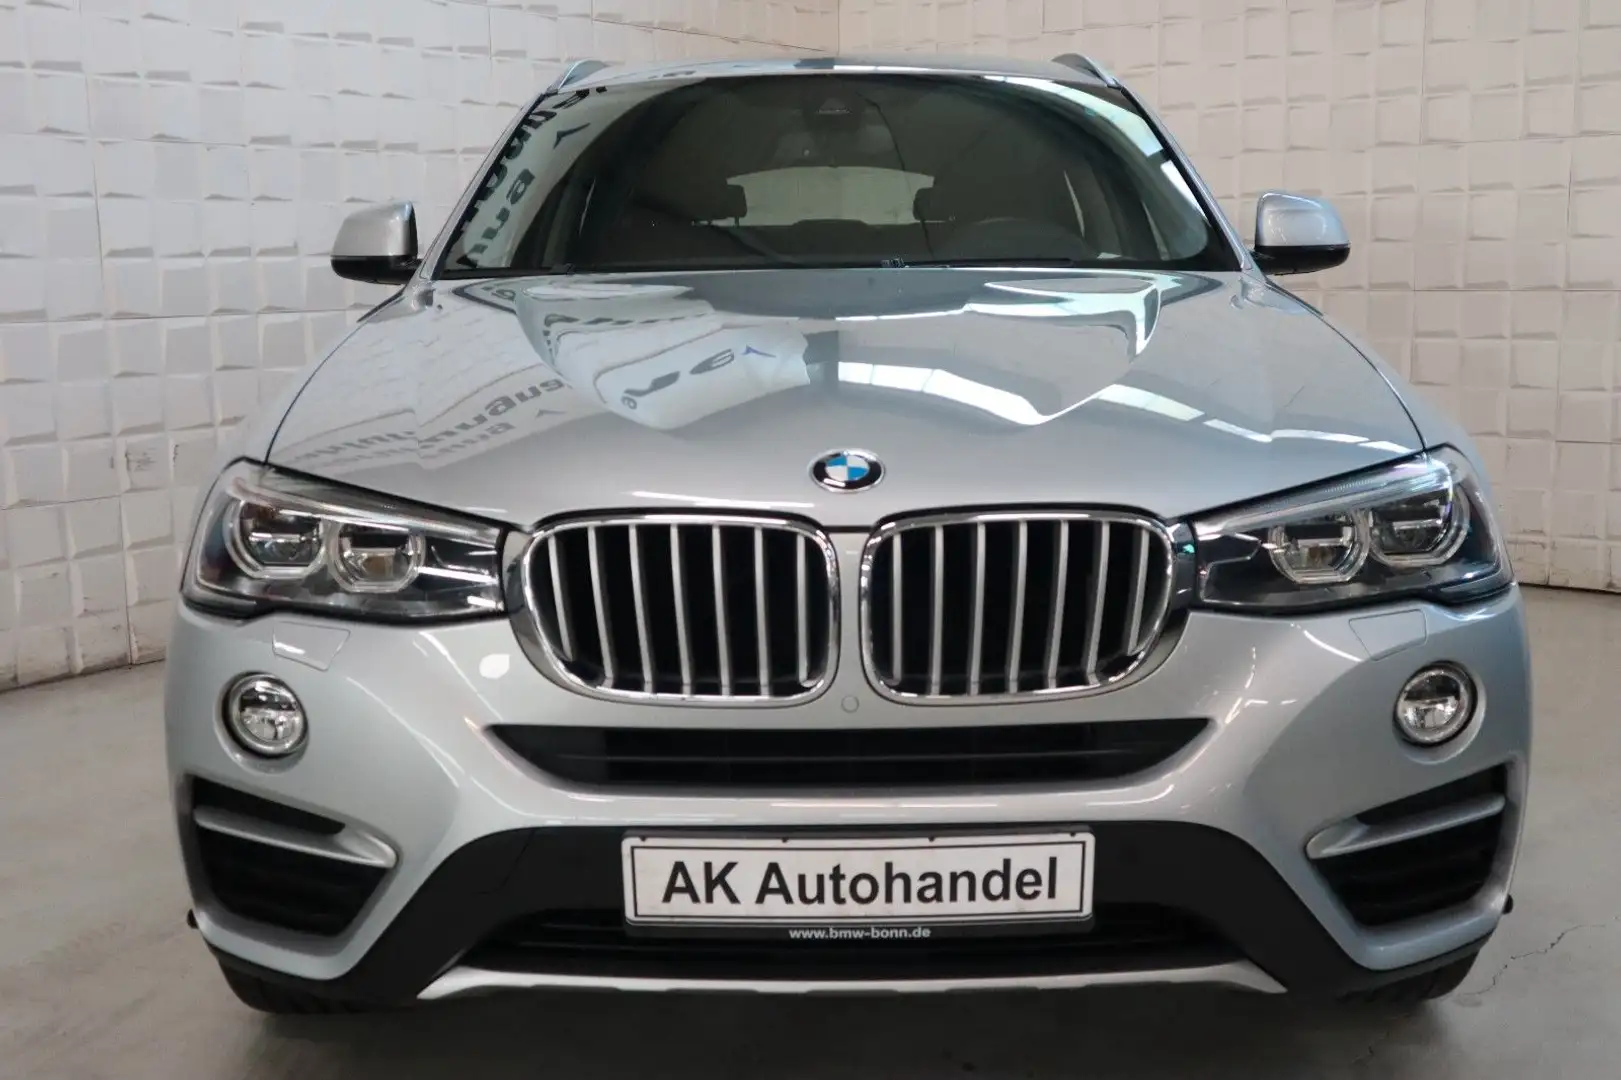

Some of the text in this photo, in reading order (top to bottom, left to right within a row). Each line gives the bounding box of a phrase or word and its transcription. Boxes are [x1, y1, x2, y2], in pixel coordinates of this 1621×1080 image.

[661, 856, 1058, 905] AK Autohandel
[788, 925, 932, 940] www.bmw-bonn.de
